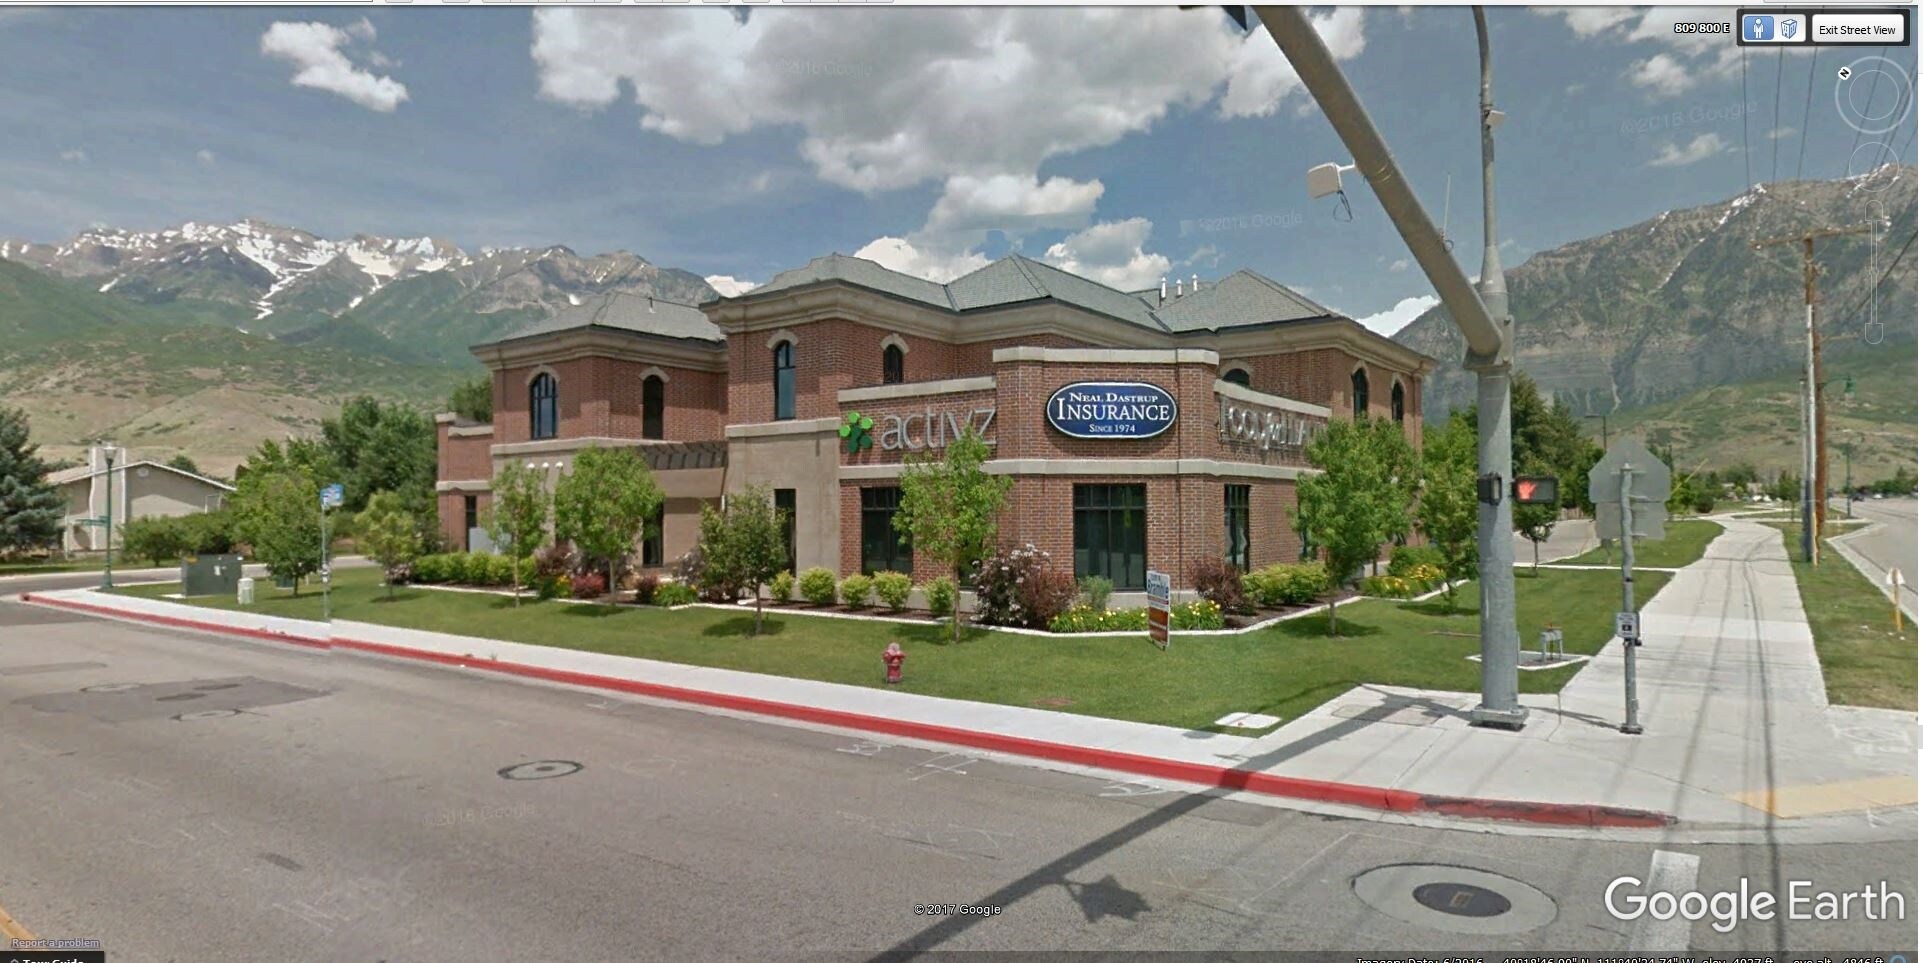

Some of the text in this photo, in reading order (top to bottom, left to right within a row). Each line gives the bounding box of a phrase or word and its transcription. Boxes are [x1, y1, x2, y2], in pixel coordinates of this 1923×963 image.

[1069, 392, 1158, 402] NEAL DASTRUP
[1057, 398, 1170, 420] INSURANCE
[1115, 424, 1135, 433] 1974
